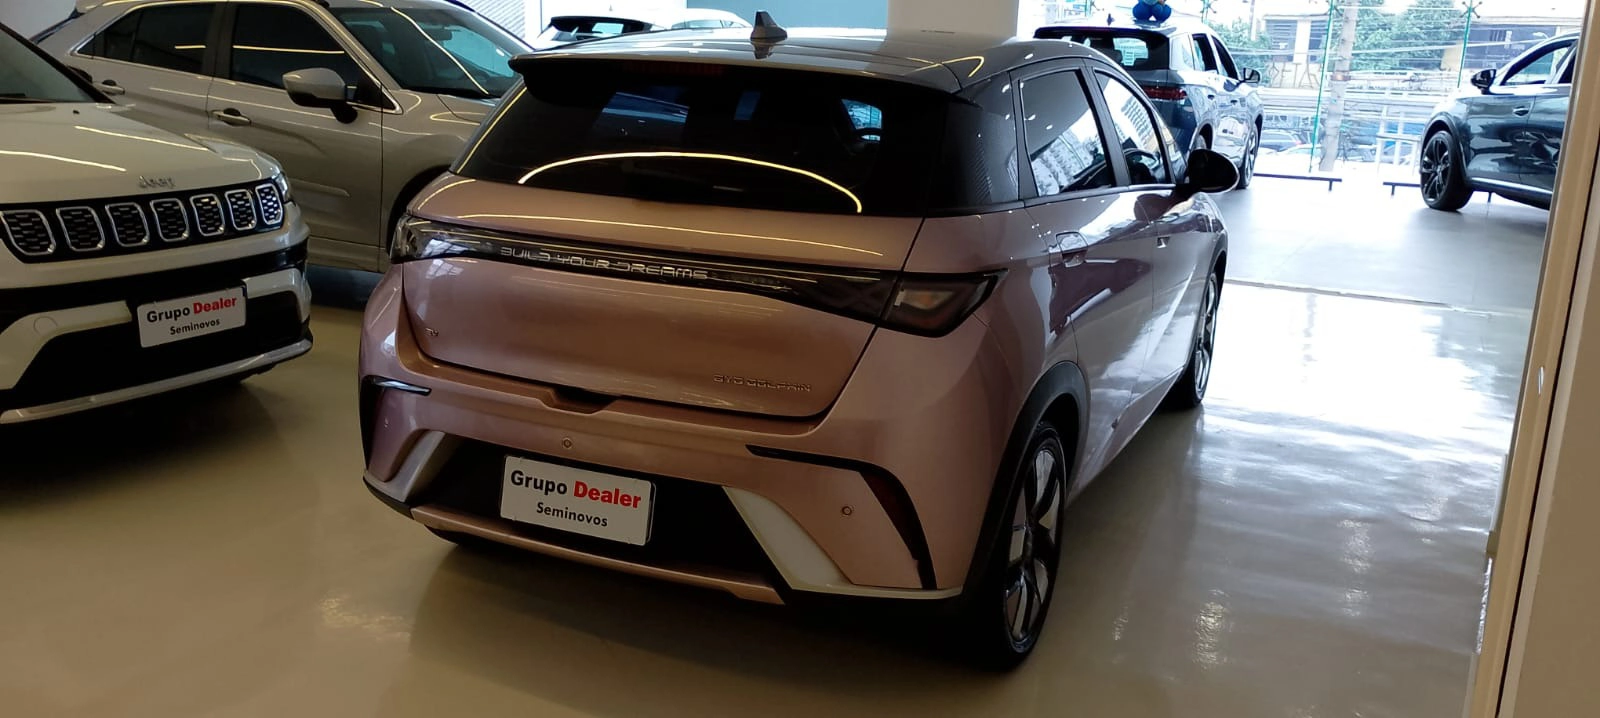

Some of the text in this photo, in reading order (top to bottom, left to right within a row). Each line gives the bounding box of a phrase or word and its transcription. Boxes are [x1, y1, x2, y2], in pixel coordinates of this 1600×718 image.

[500, 246, 708, 280] BUILD YOUR DREAMS
[146, 297, 237, 324] Grupo Dealer
[170, 318, 221, 336] Seminovos
[510, 470, 642, 509] Grupo Dealer
[536, 501, 608, 527] Seminovos
